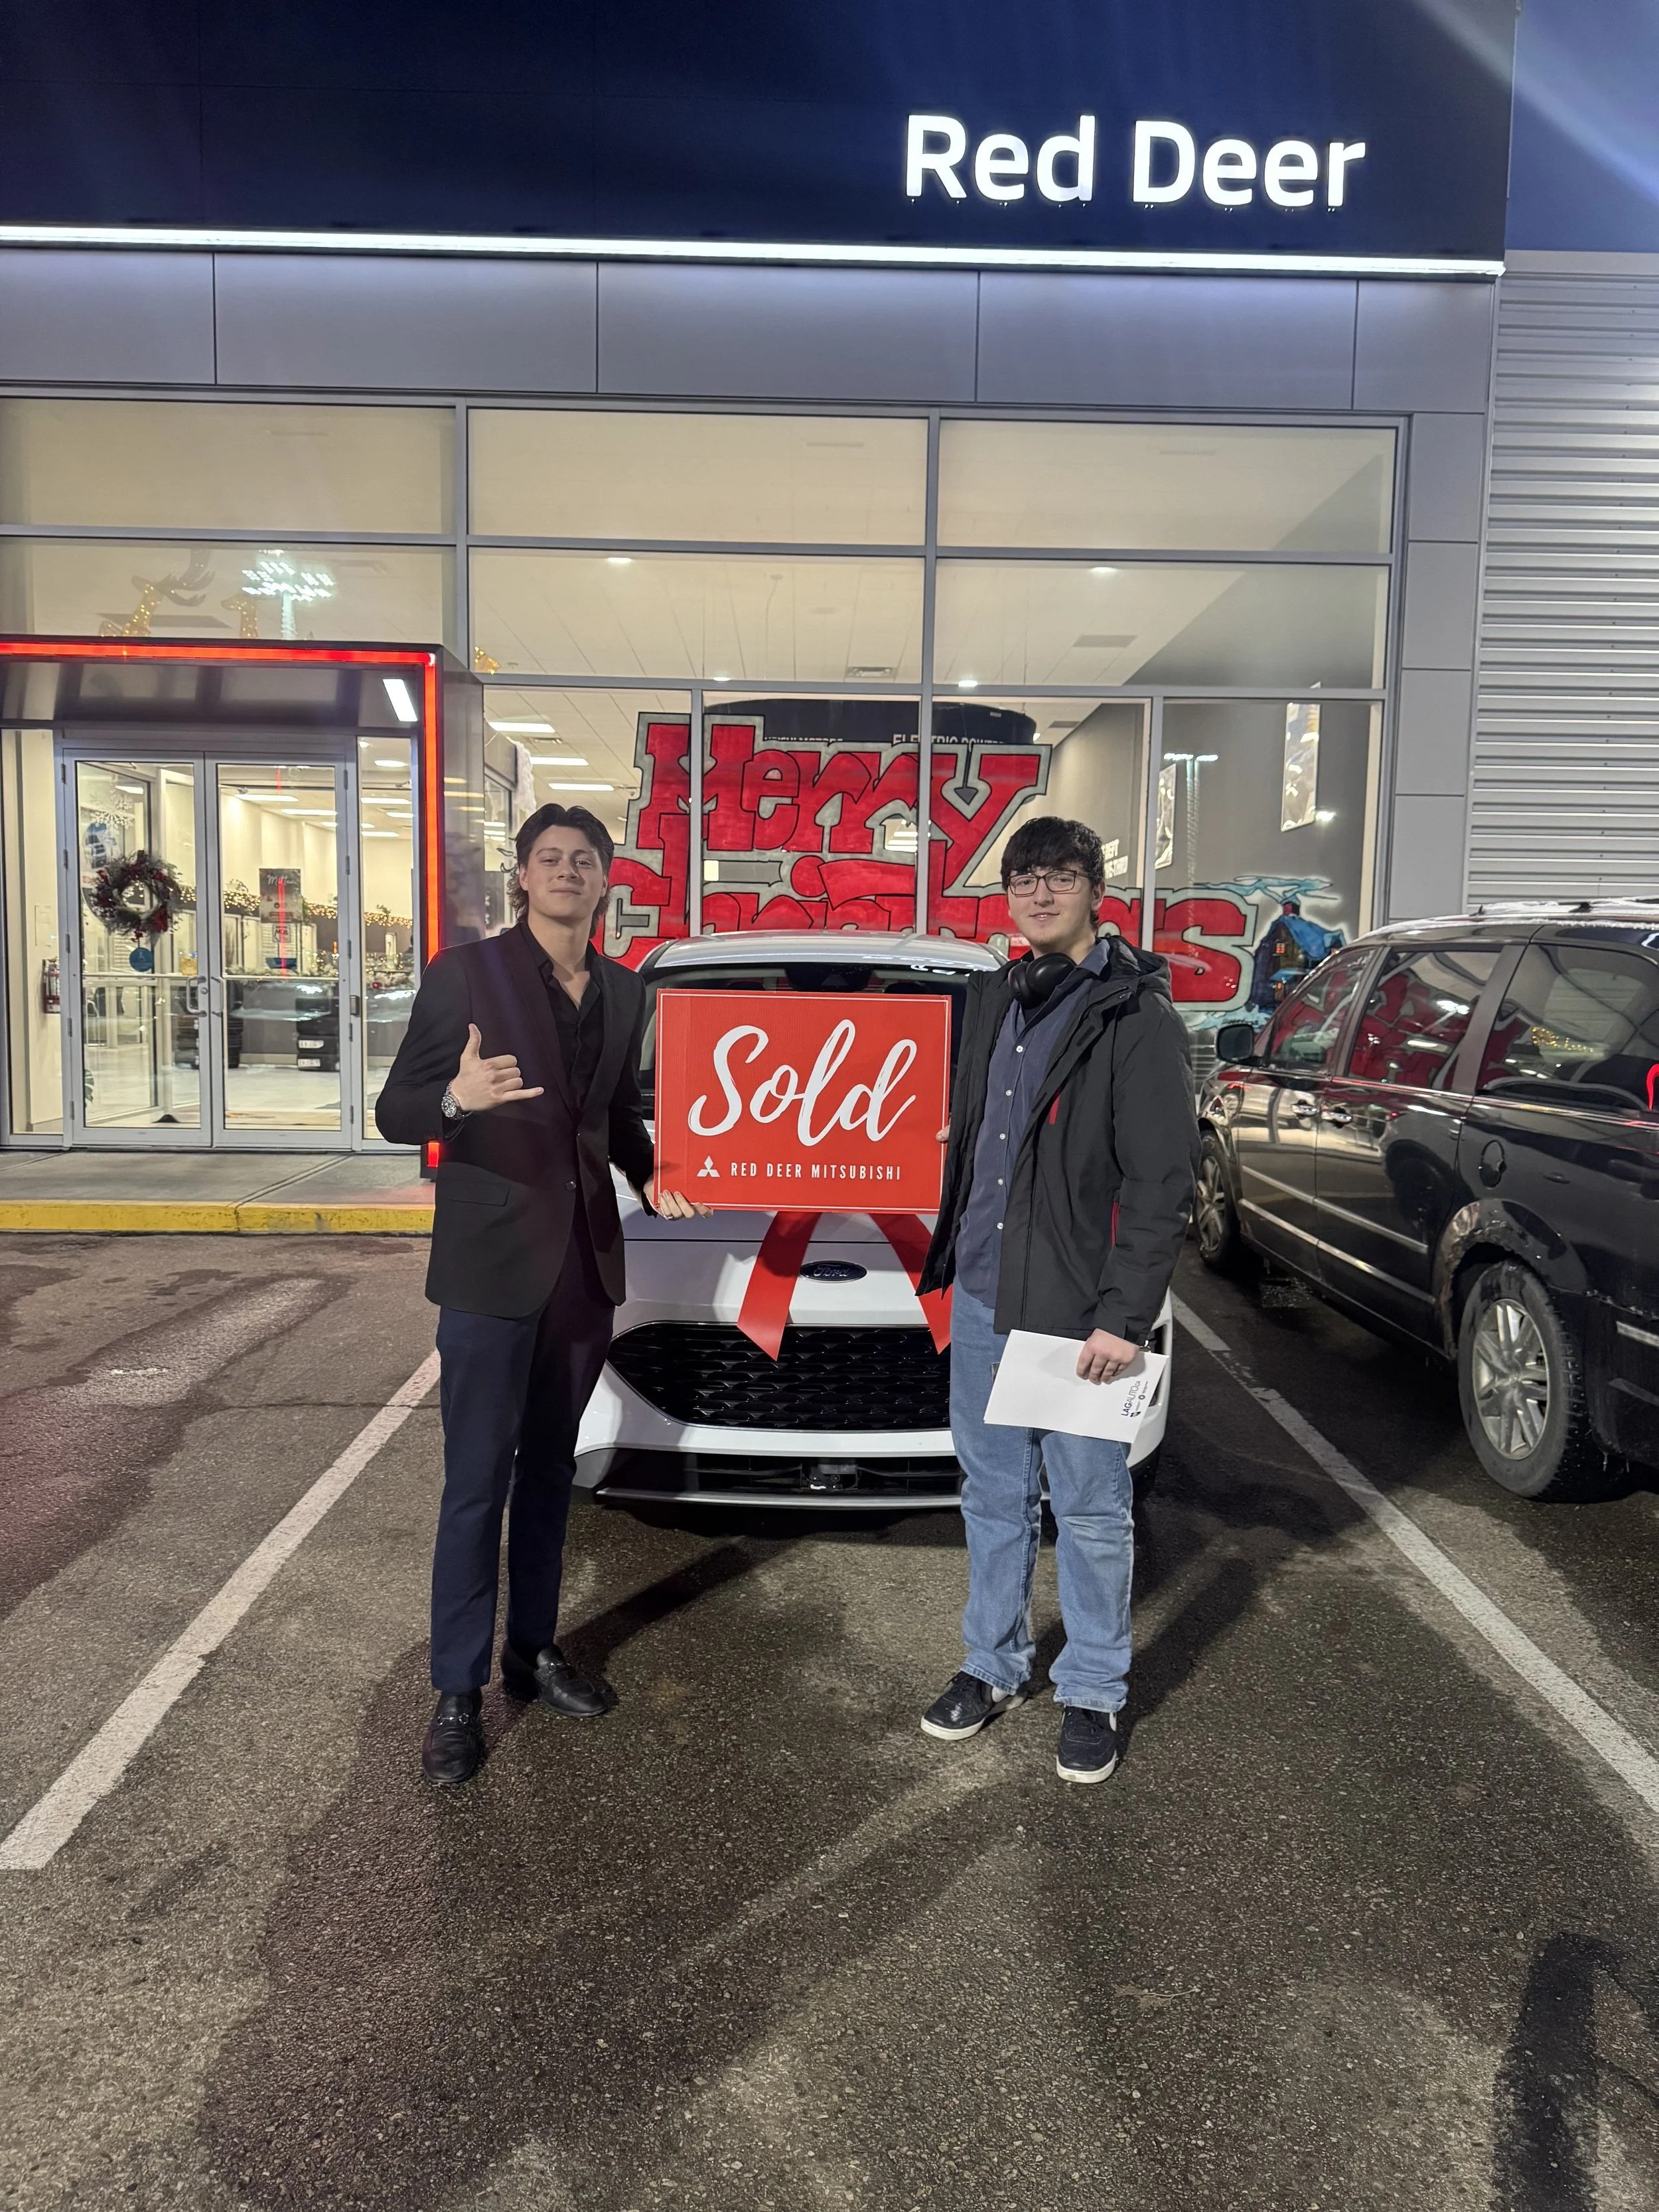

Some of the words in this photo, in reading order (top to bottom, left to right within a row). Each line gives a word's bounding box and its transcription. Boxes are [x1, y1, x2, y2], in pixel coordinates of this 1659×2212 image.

[906, 114, 1096, 202] Red
[1132, 119, 1366, 207] Deer
[892, 733, 958, 745] ELETRIC
[687, 1019, 917, 1147] Sold
[731, 1162, 757, 1177] RED
[766, 1163, 802, 1179] DEER
[811, 1164, 901, 1181] MITSUBISHI
[814, 1264, 850, 1277] Ford
